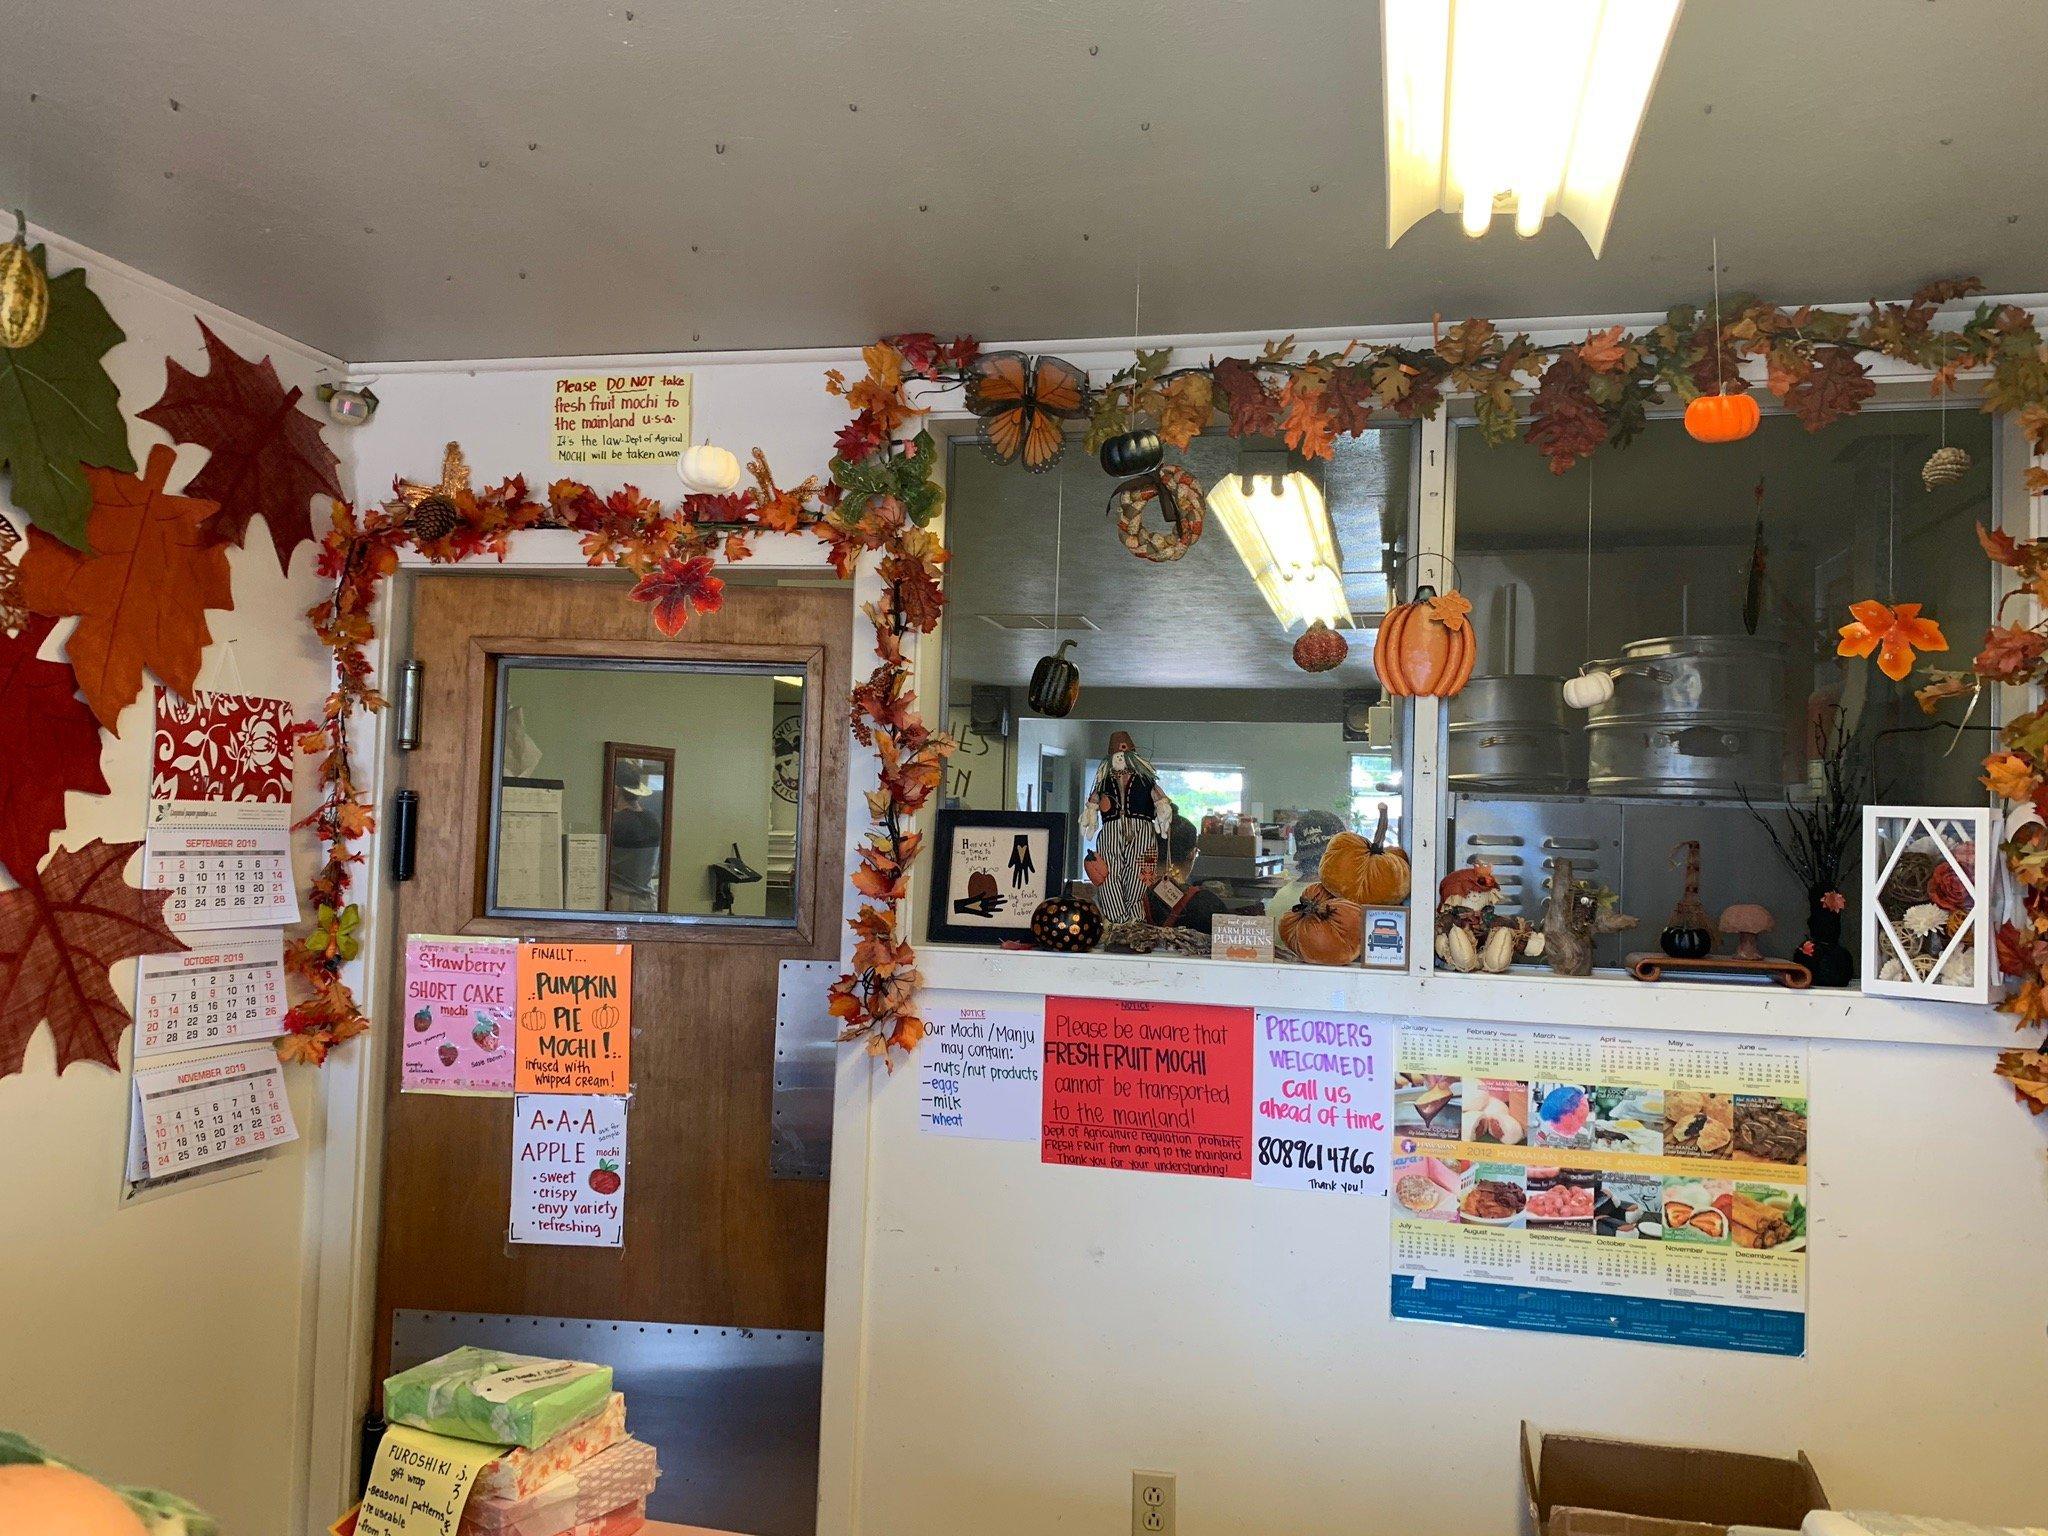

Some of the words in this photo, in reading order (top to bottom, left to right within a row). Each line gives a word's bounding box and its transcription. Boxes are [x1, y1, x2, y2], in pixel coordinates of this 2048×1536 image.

[557, 380, 596, 393] Please
[607, 378, 625, 391] DO
[631, 376, 654, 388] NOT
[661, 375, 685, 386] take
[555, 397, 586, 412] fresh
[590, 395, 615, 410] fruit
[622, 394, 658, 410] mochi
[666, 392, 680, 407] to
[555, 417, 576, 430] the
[582, 412, 634, 430] mainland
[556, 436, 574, 446] It's
[582, 435, 598, 446] the
[626, 434, 642, 446] Dept
[644, 434, 653, 442] of
[559, 450, 586, 461] MOCHI
[592, 451, 606, 460] will
[612, 450, 622, 459] be
[626, 448, 654, 458] taken
[186, 839, 232, 848] SEPTEMBER
[236, 839, 258, 848] 2019
[962, 836, 996, 849] Harvest
[966, 856, 988, 864] gather
[174, 900, 186, 908] 23
[196, 899, 206, 908] 24
[1218, 926, 1240, 934] FARM
[1214, 934, 1272, 946] PUMPKINS
[184, 954, 220, 966] OCTOBER
[224, 953, 244, 962] 2019
[420, 953, 506, 978] Strawberry
[409, 980, 457, 1000] SHORT
[464, 984, 504, 1003] CAKE
[536, 972, 616, 1004] PUMPKIN
[440, 1004, 468, 1016] mochi
[960, 1009, 986, 1018] NOTICE
[554, 1006, 582, 1032] PIE
[924, 1022, 945, 1036] Our
[951, 1023, 983, 1038] Mochi
[1056, 1015, 1108, 1038] Please
[1114, 1017, 1133, 1039] be
[1140, 1024, 1190, 1043] aware
[1195, 1024, 1228, 1045] that
[1266, 1015, 1372, 1048] PREORDERS
[1401, 1024, 1428, 1032] January
[1466, 1028, 1498, 1037] February
[1533, 1032, 1556, 1040] March
[1600, 1035, 1616, 1044] April
[1668, 1040, 1684, 1048] May
[941, 1042, 964, 1060] may
[968, 1044, 1014, 1060] contain:
[1044, 1042, 1099, 1068] FRESH
[1104, 1044, 1152, 1072] FRUIT
[1156, 1050, 1206, 1076] MOCHI
[178, 1069, 222, 1084] NOVEMBER
[225, 1063, 246, 1074] 2019
[526, 1057, 559, 1074] infused
[565, 1058, 591, 1074] with
[990, 1066, 1038, 1081] products
[1269, 1050, 1374, 1082] WELCOMED!
[535, 1074, 570, 1088] whipped
[1055, 1075, 1104, 1094] cannot
[1114, 1076, 1131, 1097] be
[1137, 1078, 1230, 1108] transported
[1324, 1086, 1352, 1104] us
[1054, 1100, 1070, 1121] to
[1077, 1102, 1104, 1123] the
[1113, 1108, 1195, 1129] mainland!
[1259, 1098, 1312, 1124] ahead
[1318, 1106, 1340, 1127] of
[1342, 1106, 1384, 1132] time
[598, 1131, 620, 1142] sample
[1044, 1125, 1064, 1138] Dept
[1068, 1126, 1079, 1138] of
[1084, 1127, 1138, 1141] Agriculture
[1142, 1132, 1192, 1144] regulation
[1198, 1136, 1241, 1149] prohibits
[521, 1142, 586, 1163] APPLE
[596, 1147, 620, 1156] mochi
[1045, 1140, 1074, 1151] FRESH
[1077, 1141, 1104, 1152] FRUIT
[1109, 1142, 1130, 1154] from
[1135, 1144, 1160, 1158] going
[1163, 1146, 1172, 1158] to
[1176, 1147, 1192, 1158] the
[1195, 1150, 1242, 1161] mainland
[1467, 1147, 1493, 1158] 2012
[1497, 1150, 1559, 1162] HAWAIIAN
[1562, 1154, 1613, 1166] CHOICE
[1617, 1159, 1670, 1170] AWARDS
[1056, 1153, 1088, 1164] Thank
[1090, 1156, 1106, 1166] you
[1111, 1157, 1124, 1168] for
[1128, 1160, 1149, 1170] your
[1154, 1161, 1228, 1176] understanding!
[1327, 1146, 1375, 1174] 4766
[540, 1171, 576, 1184] sweet
[540, 1186, 577, 1201] crispy
[1308, 1179, 1337, 1192] Thank
[1341, 1180, 1364, 1194] you!
[538, 1203, 568, 1218] envy
[574, 1201, 618, 1219] variety
[538, 1217, 602, 1237] refreshing
[1398, 1221, 1412, 1231] July
[1463, 1228, 1488, 1236] August
[1530, 1233, 1566, 1242] September
[1597, 1239, 1626, 1248] October
[1665, 1244, 1704, 1254] November
[1736, 1250, 1775, 1260] December
[389, 1444, 452, 1476] FUROSHIKI
[390, 1467, 404, 1482] gift
[408, 1474, 426, 1490] wrap
[371, 1485, 409, 1506] seasonal
[410, 1500, 445, 1522] patterns
[360, 1519, 380, 1536] from
